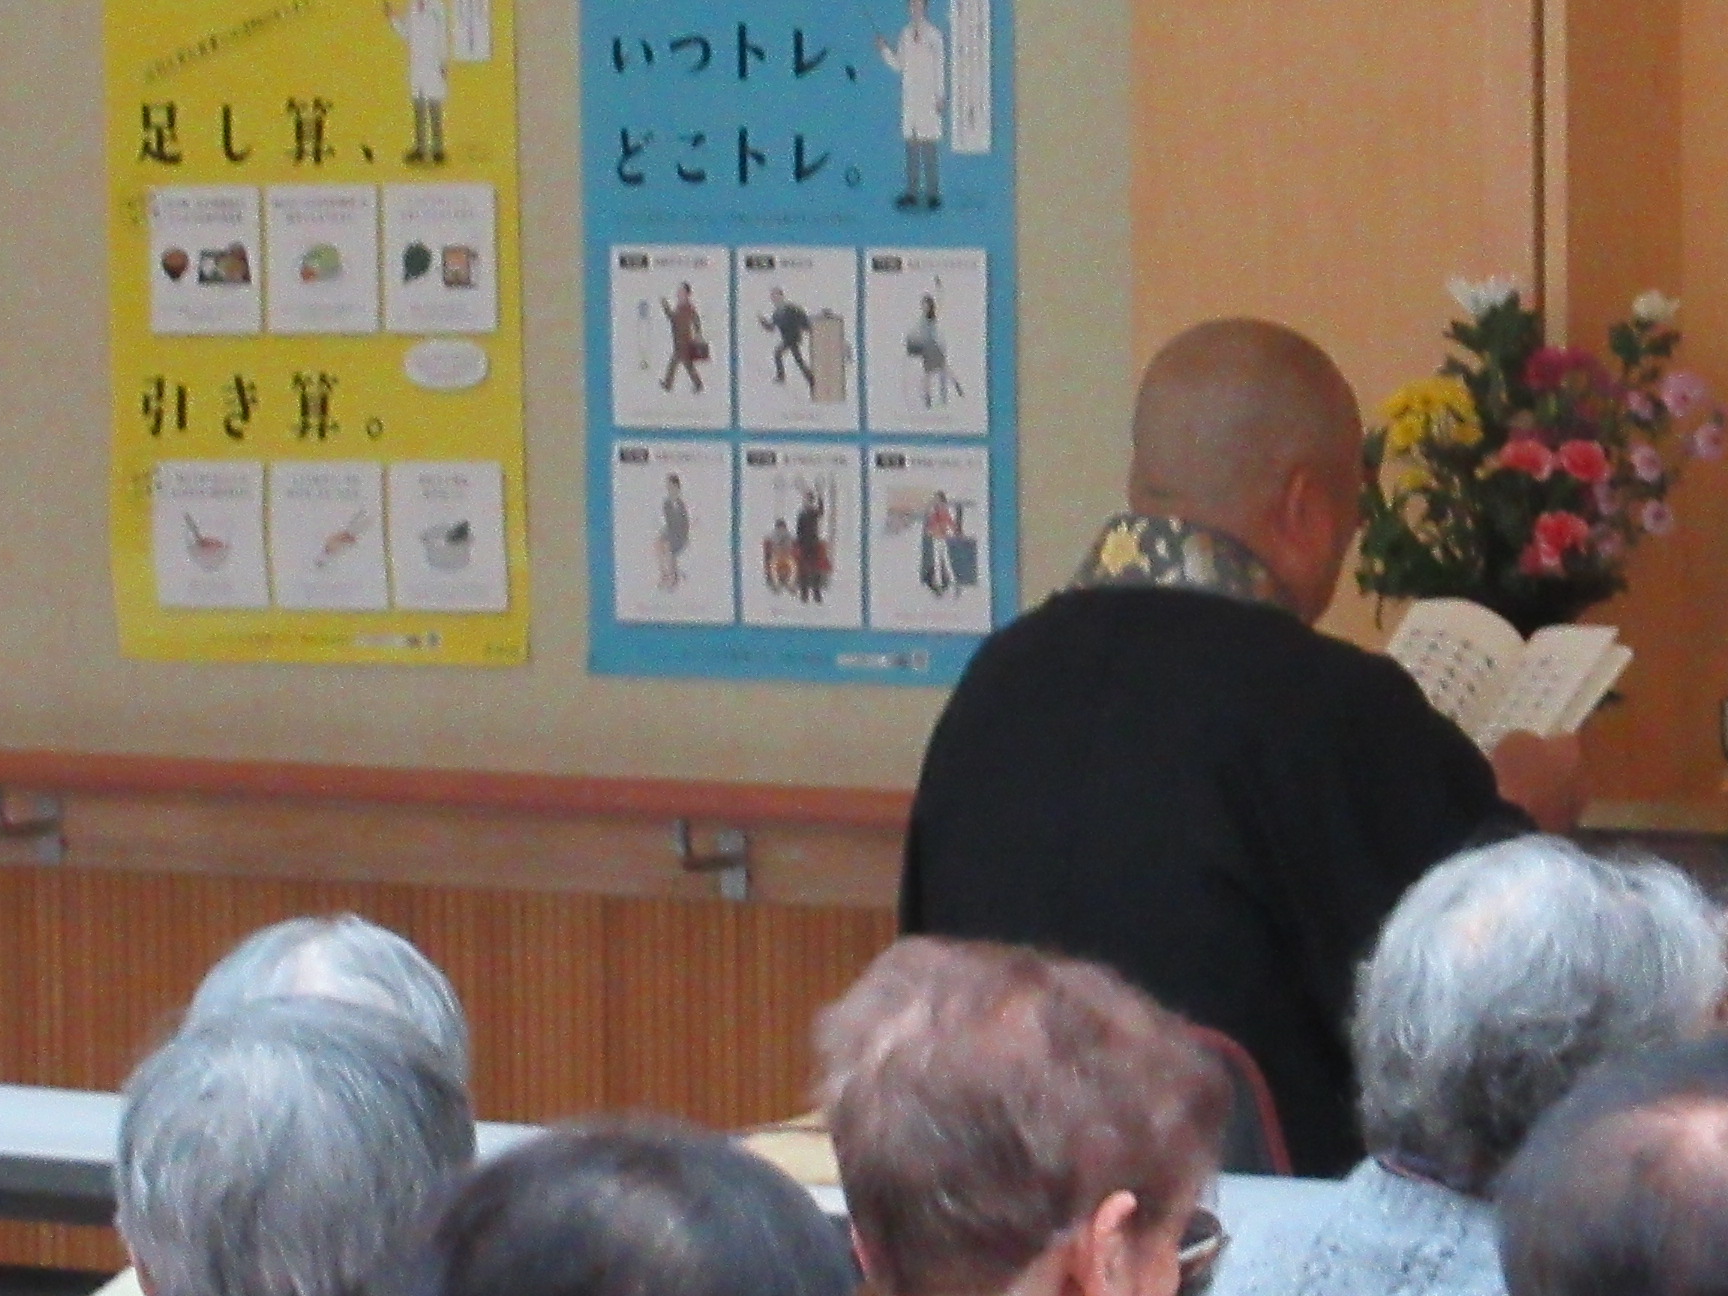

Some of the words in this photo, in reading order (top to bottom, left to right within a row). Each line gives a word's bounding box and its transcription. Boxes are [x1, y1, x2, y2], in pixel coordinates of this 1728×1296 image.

[612, 21, 857, 82] いつトレ、
[617, 125, 862, 186] どこトレ。
